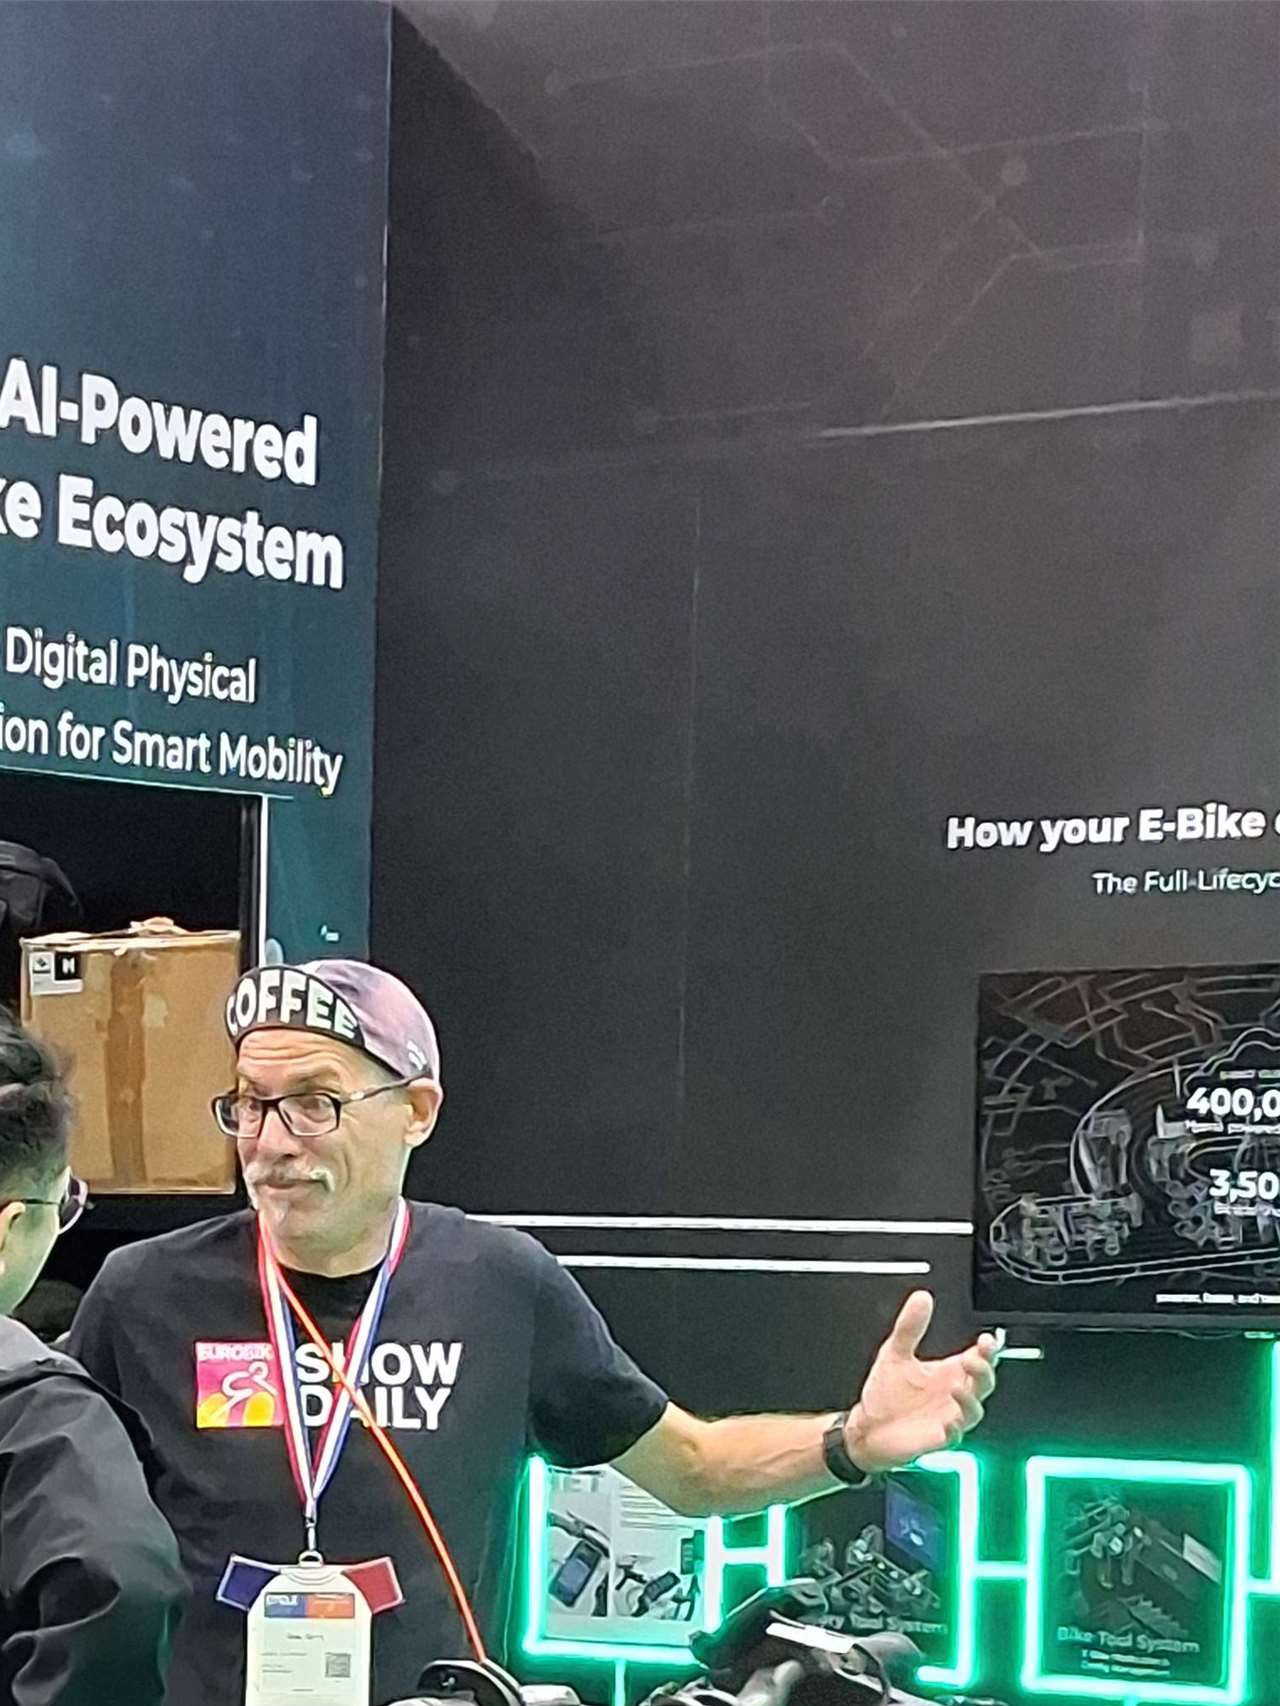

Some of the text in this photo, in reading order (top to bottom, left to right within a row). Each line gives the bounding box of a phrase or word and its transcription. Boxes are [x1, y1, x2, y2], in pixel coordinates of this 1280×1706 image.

[57, 473, 345, 589] Ecosystem
[5, 626, 118, 690] Digital
[126, 643, 257, 704] Physical
[58, 714, 106, 760] for
[112, 719, 212, 773] Smart
[218, 732, 344, 795] Mobility
[947, 817, 1034, 848] How
[1039, 816, 1130, 853] your
[1138, 801, 1266, 842] E-Bike
[1092, 872, 1137, 895] The
[226, 969, 358, 1039] COFFEE
